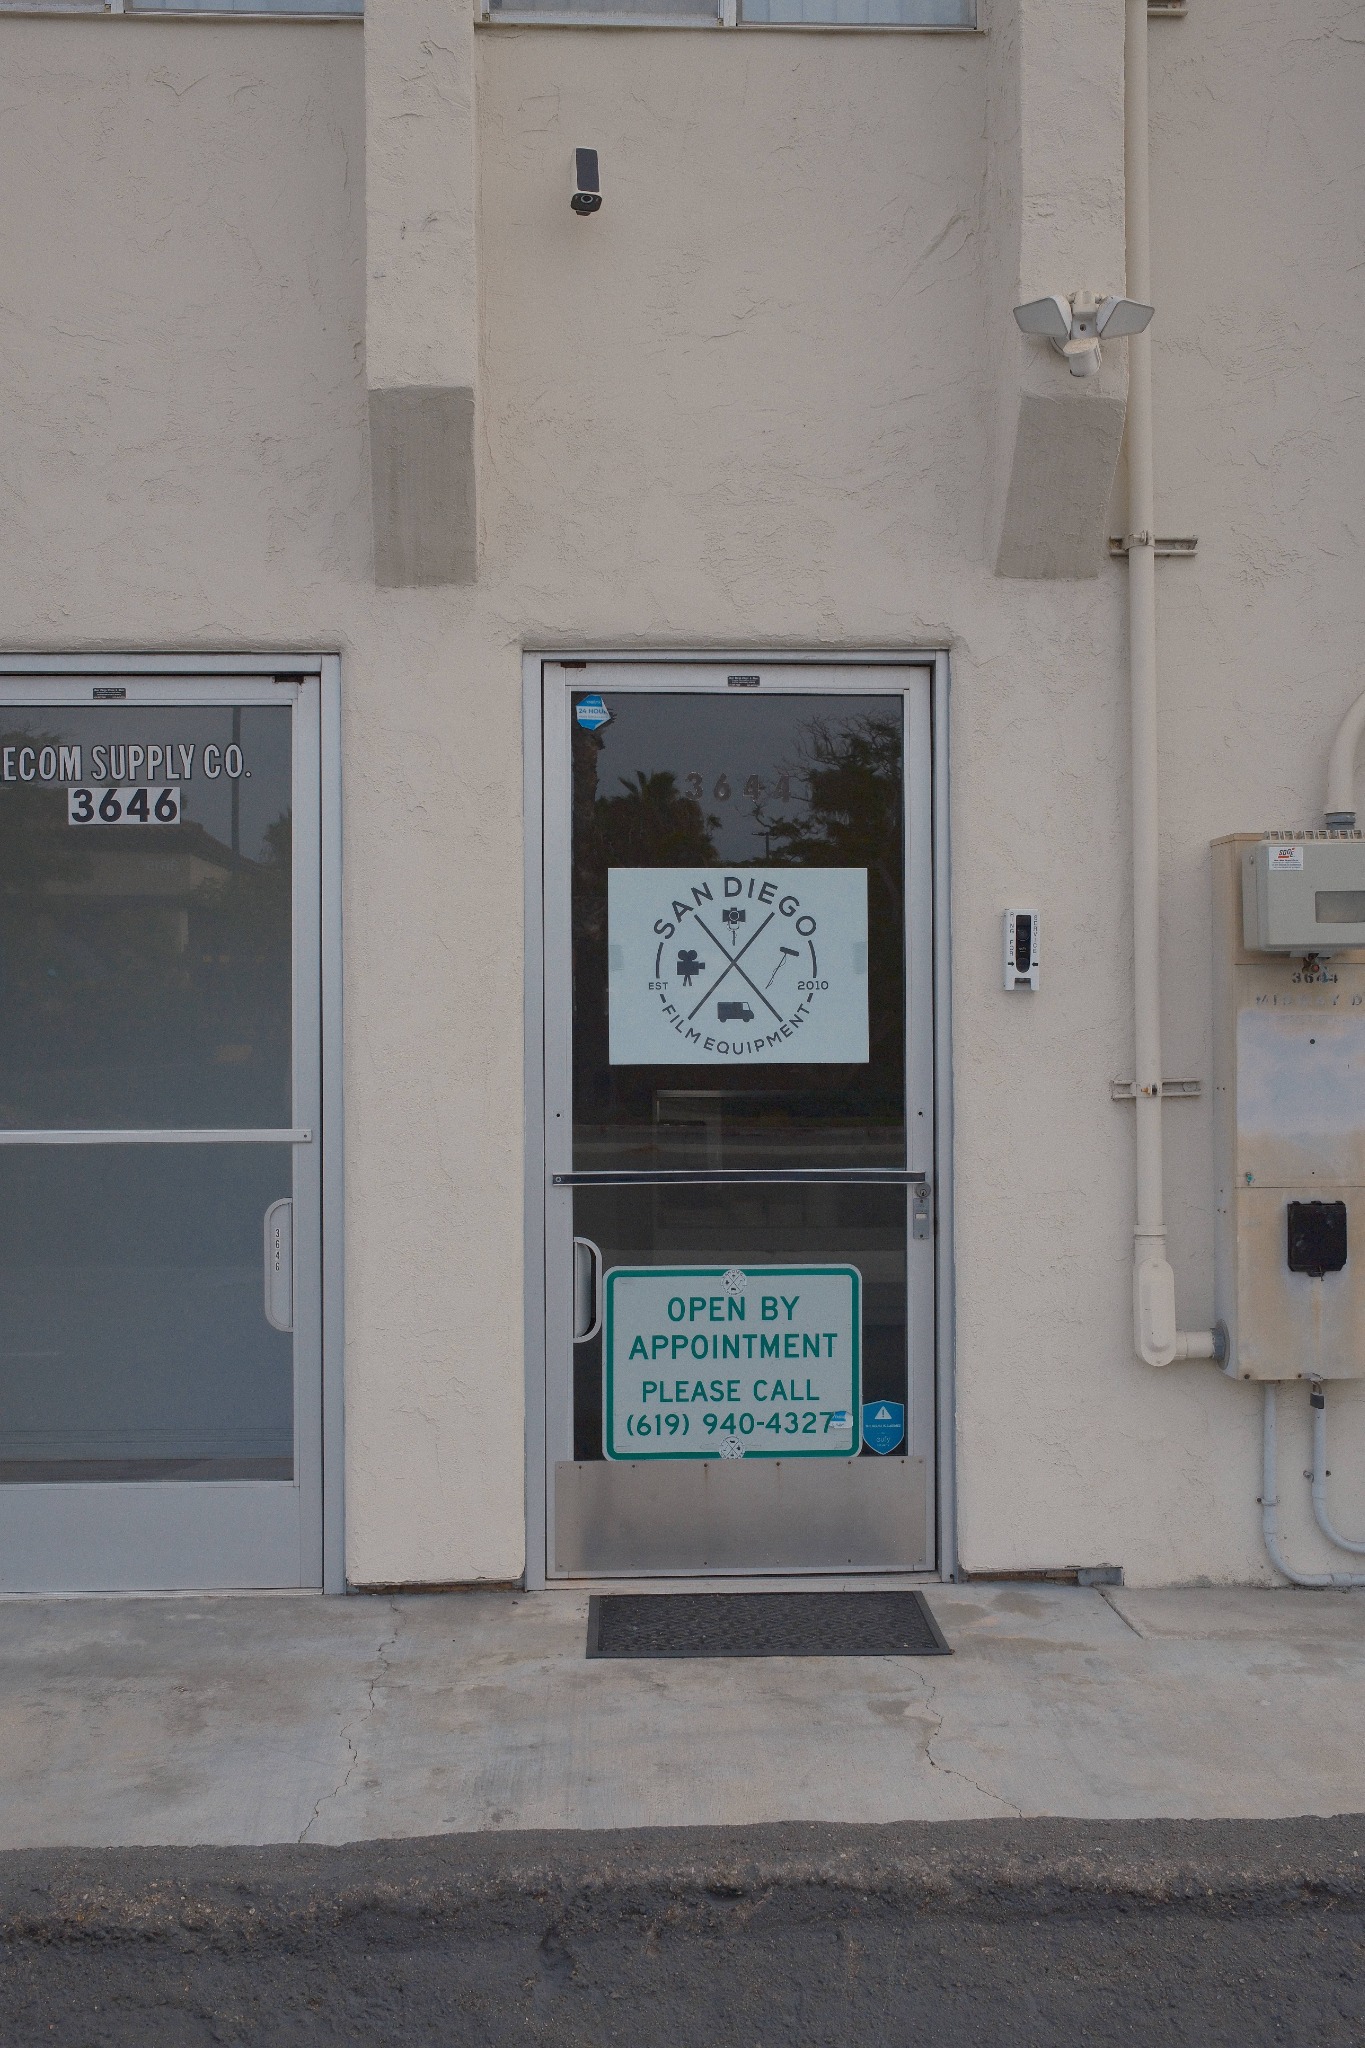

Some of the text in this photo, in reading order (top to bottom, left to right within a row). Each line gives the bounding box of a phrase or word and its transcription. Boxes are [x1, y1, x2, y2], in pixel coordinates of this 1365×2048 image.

[92, 744, 195, 780] SUPPLY
[204, 744, 251, 779] CO.
[685, 771, 791, 802] 3644
[71, 788, 178, 823] 3646
[653, 876, 817, 940] SAN DIEGO
[648, 981, 668, 991] EST
[797, 980, 829, 991] 2010
[662, 1003, 810, 1055] FILM EQUIPMENT
[667, 1295, 800, 1322] OPEN BY
[628, 1332, 838, 1361] APPOINTMENT
[642, 1378, 820, 1403] PLEASE CALL
[626, 1413, 690, 1437] (619)
[702, 1411, 834, 1435] 940-4327
